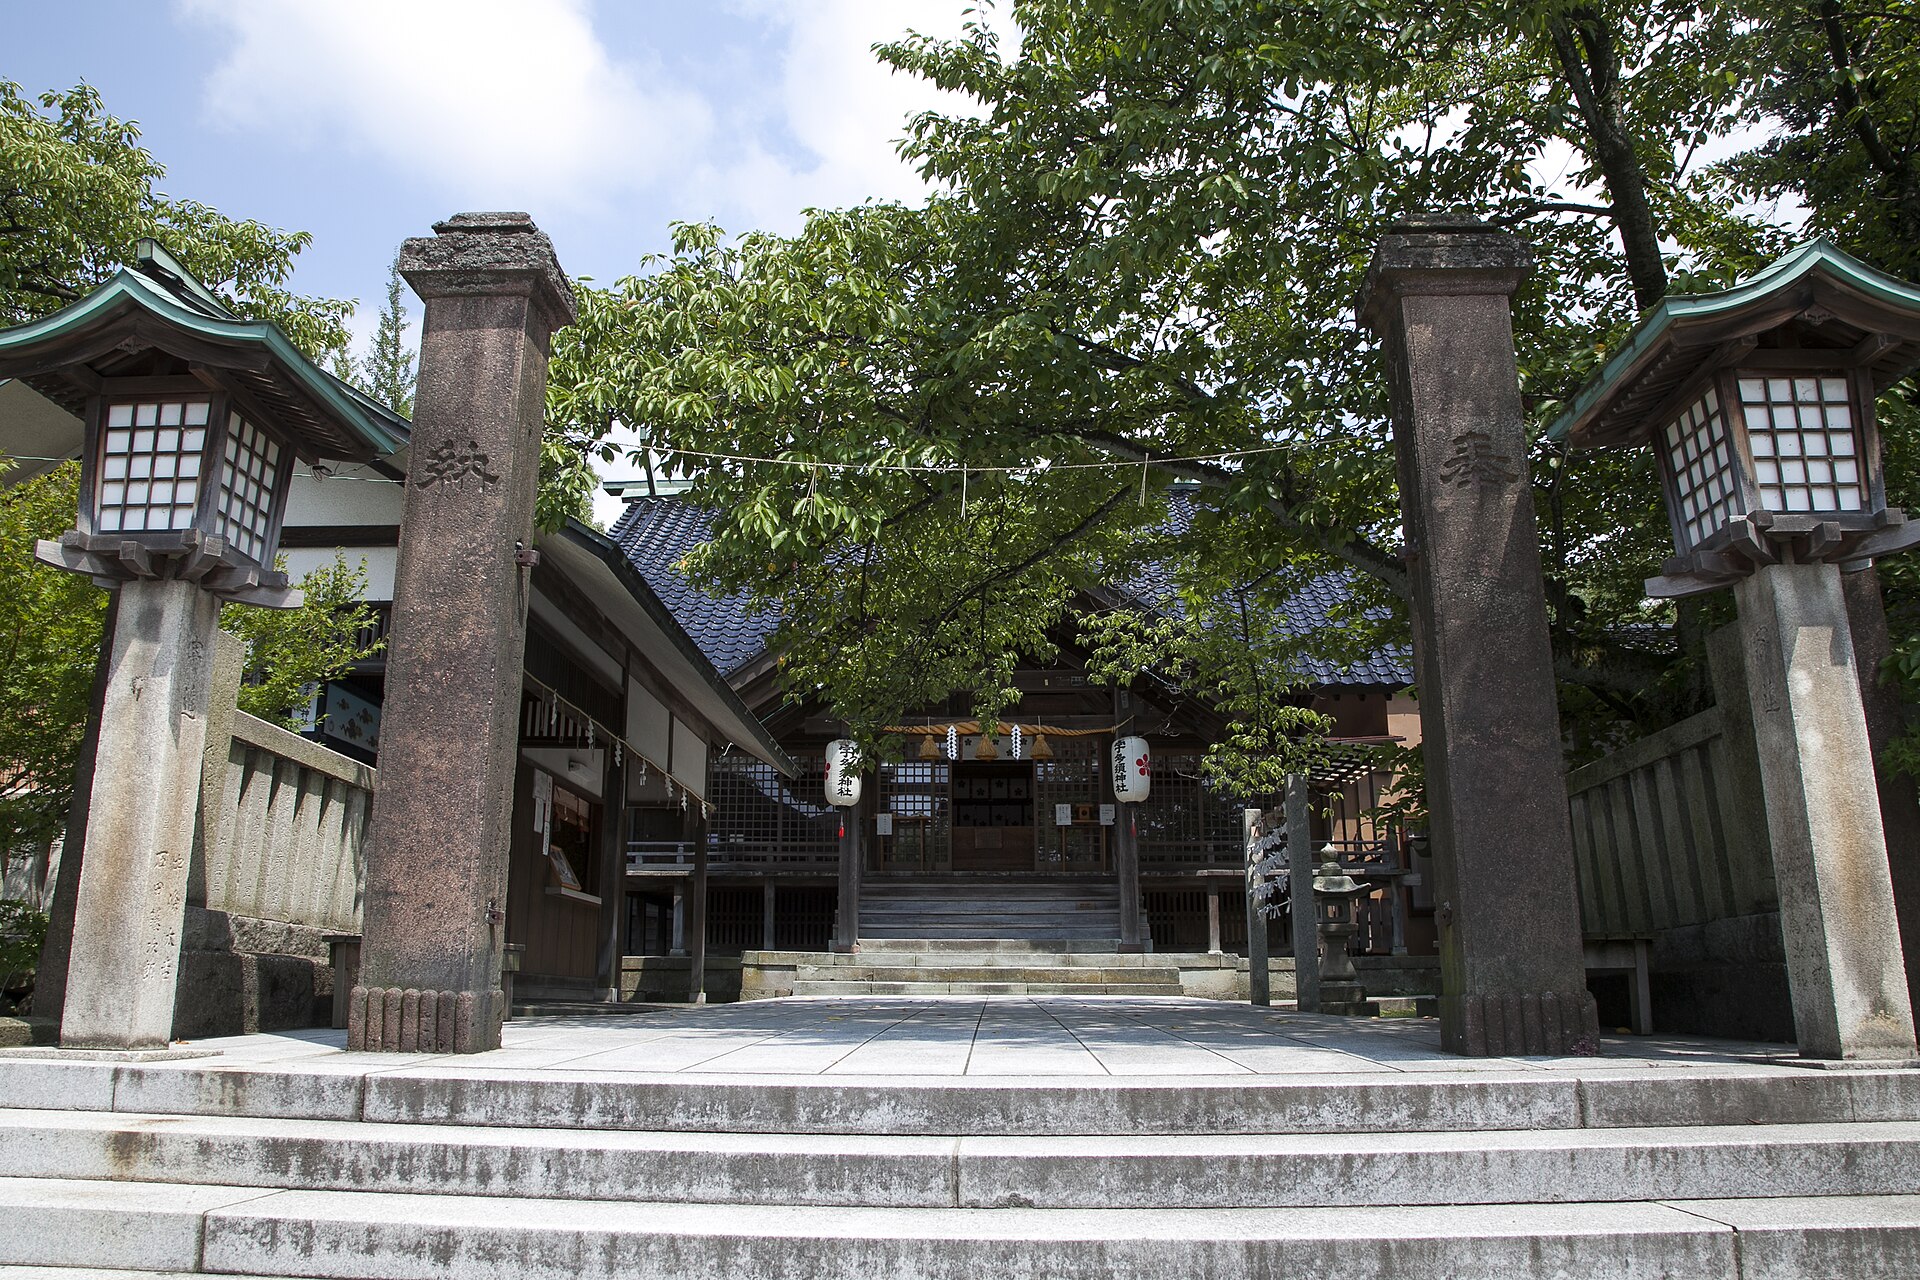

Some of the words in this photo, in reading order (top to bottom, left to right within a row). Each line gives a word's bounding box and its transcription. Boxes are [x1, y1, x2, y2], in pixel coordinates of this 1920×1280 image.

[415, 440, 500, 493] 納
[1440, 431, 1521, 491] 奉
[1114, 739, 1129, 793] 宇多須神社
